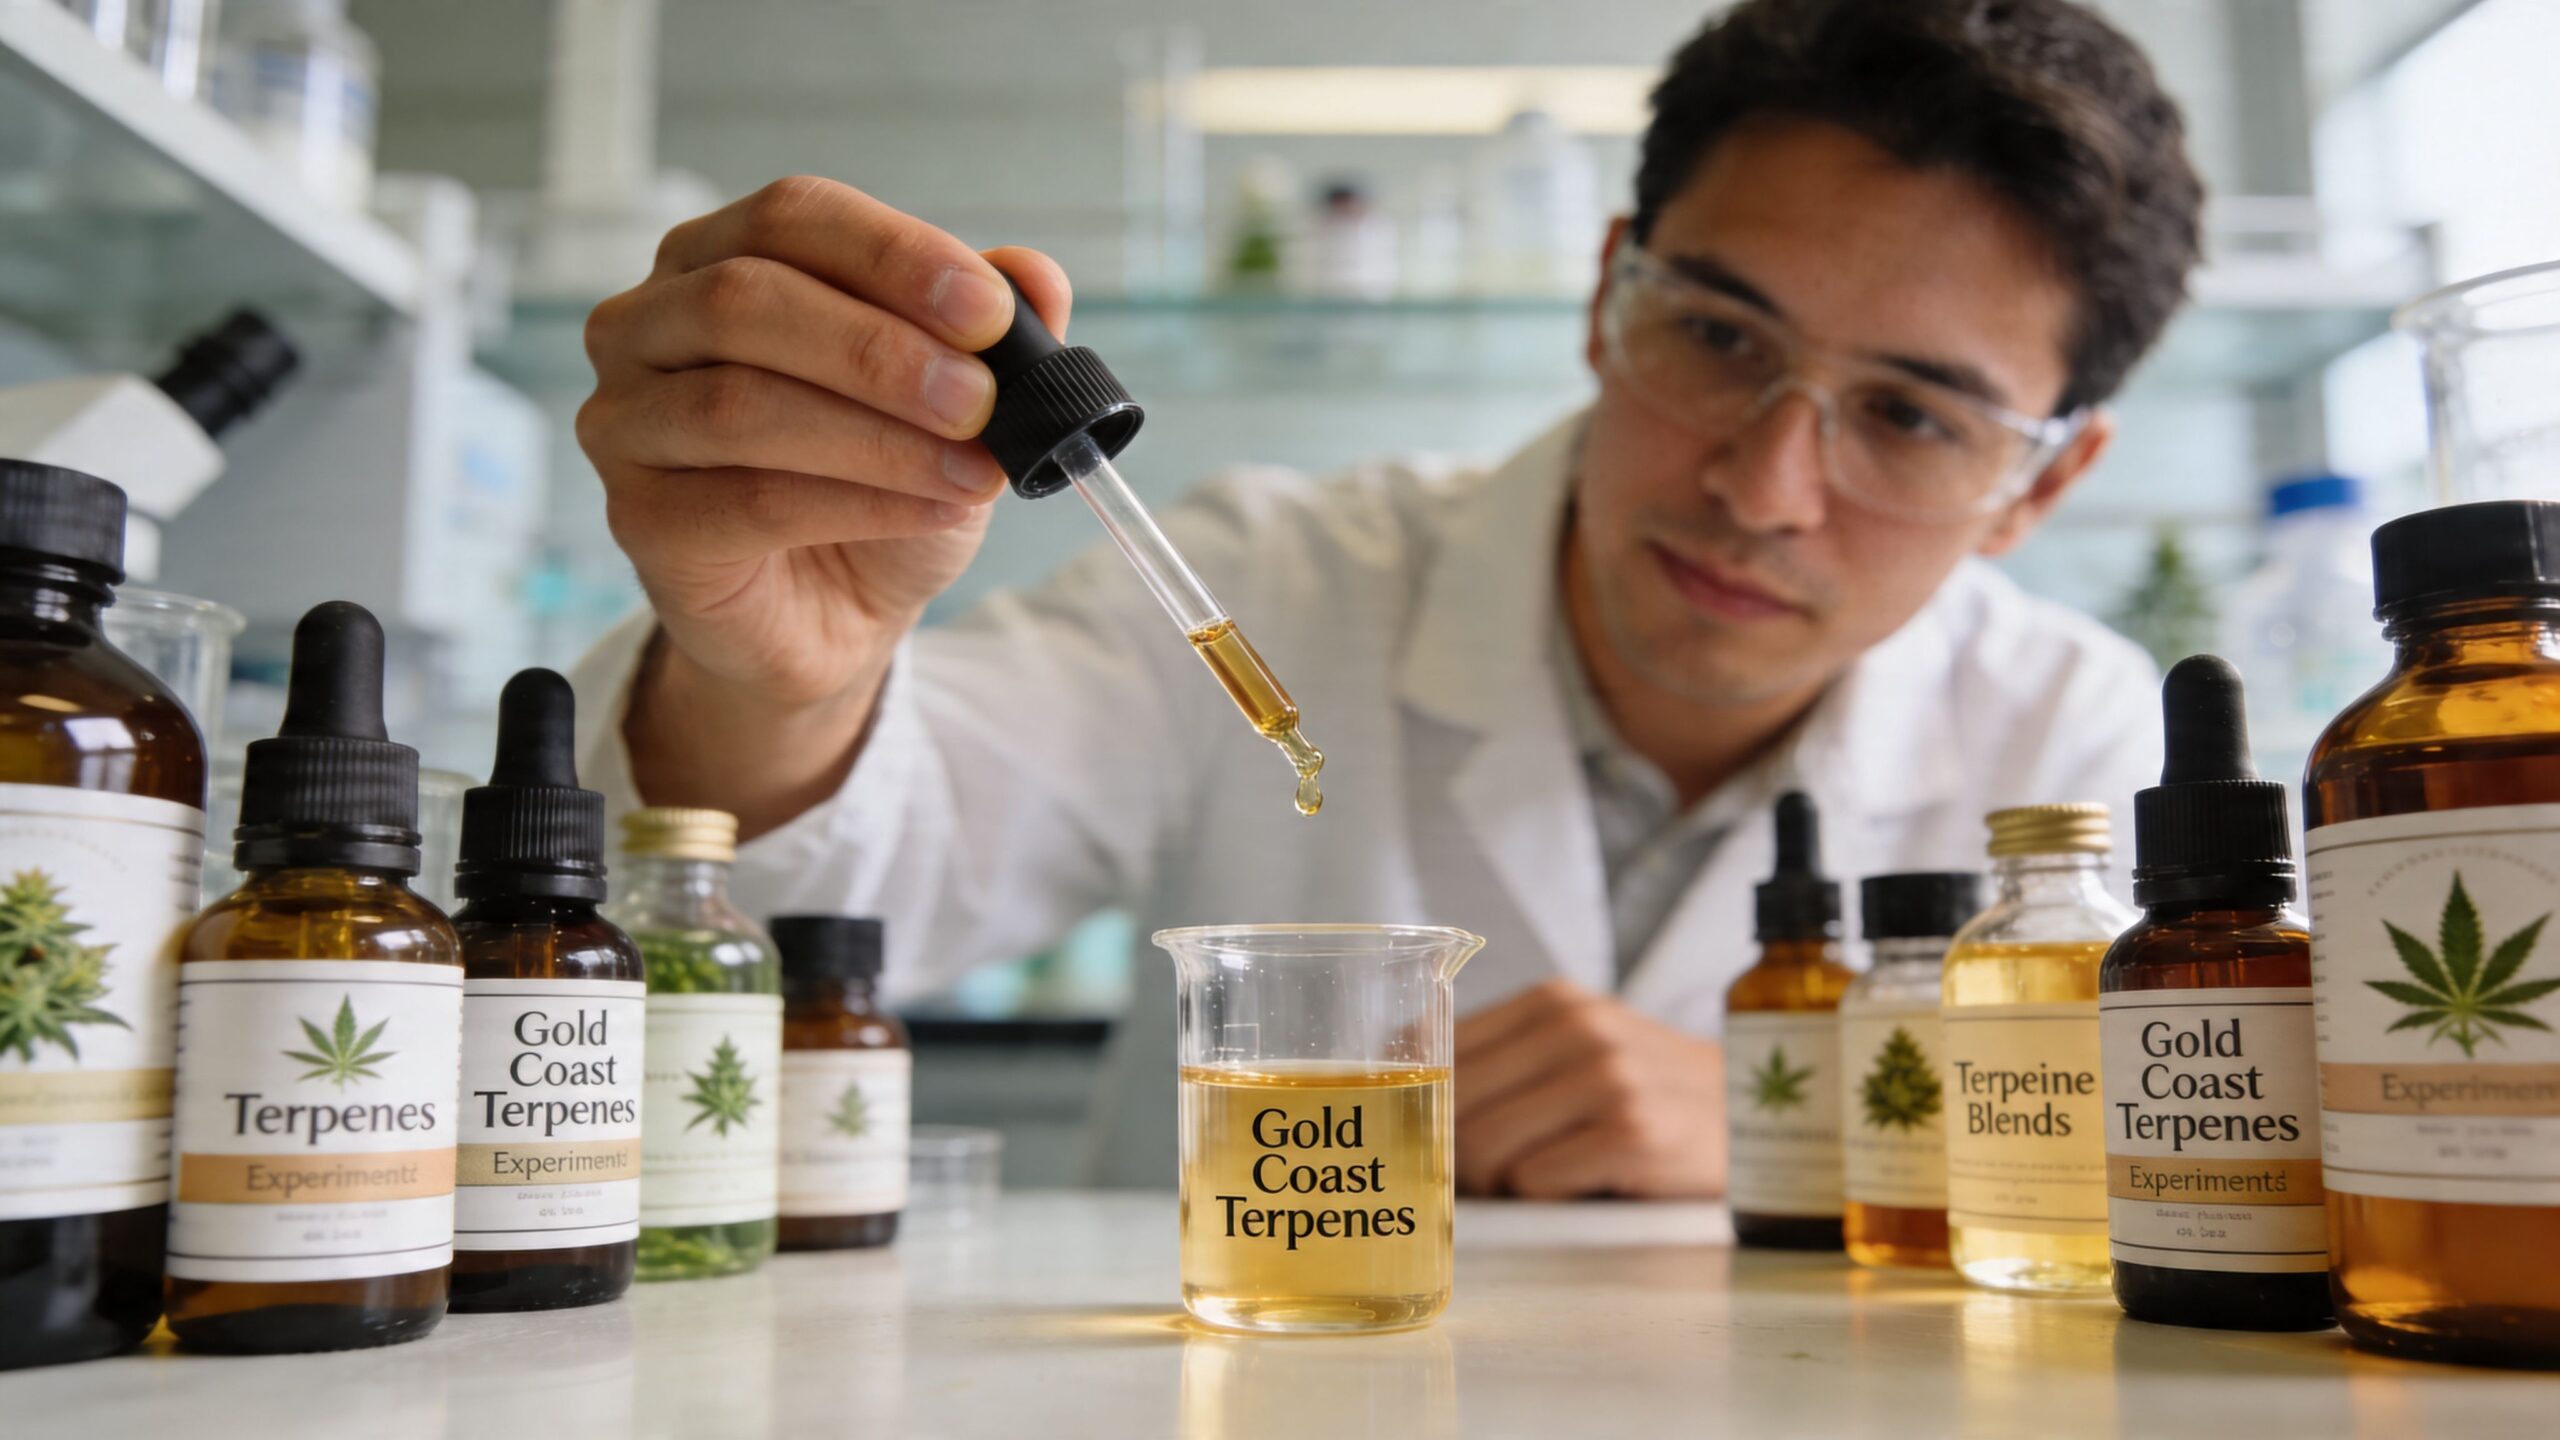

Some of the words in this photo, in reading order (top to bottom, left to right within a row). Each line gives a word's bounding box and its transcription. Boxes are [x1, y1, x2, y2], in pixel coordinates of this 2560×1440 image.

[514, 1009, 608, 1047] Gold
[2141, 1018, 2244, 1058] Gold
[509, 1052, 618, 1088] Coast
[1954, 1062, 2095, 1103] Terpeine
[2141, 1064, 2265, 1100] Coast
[225, 1093, 436, 1145] Terpenes
[474, 1091, 636, 1137] Terpenes
[1251, 1105, 1364, 1149] Gold
[1968, 1102, 2073, 1137] Blends
[2116, 1103, 2301, 1152] Terpenes
[1252, 1154, 1386, 1194] Coast
[2129, 1165, 2288, 1197] Experiments
[1215, 1195, 1416, 1251] Terpenes
